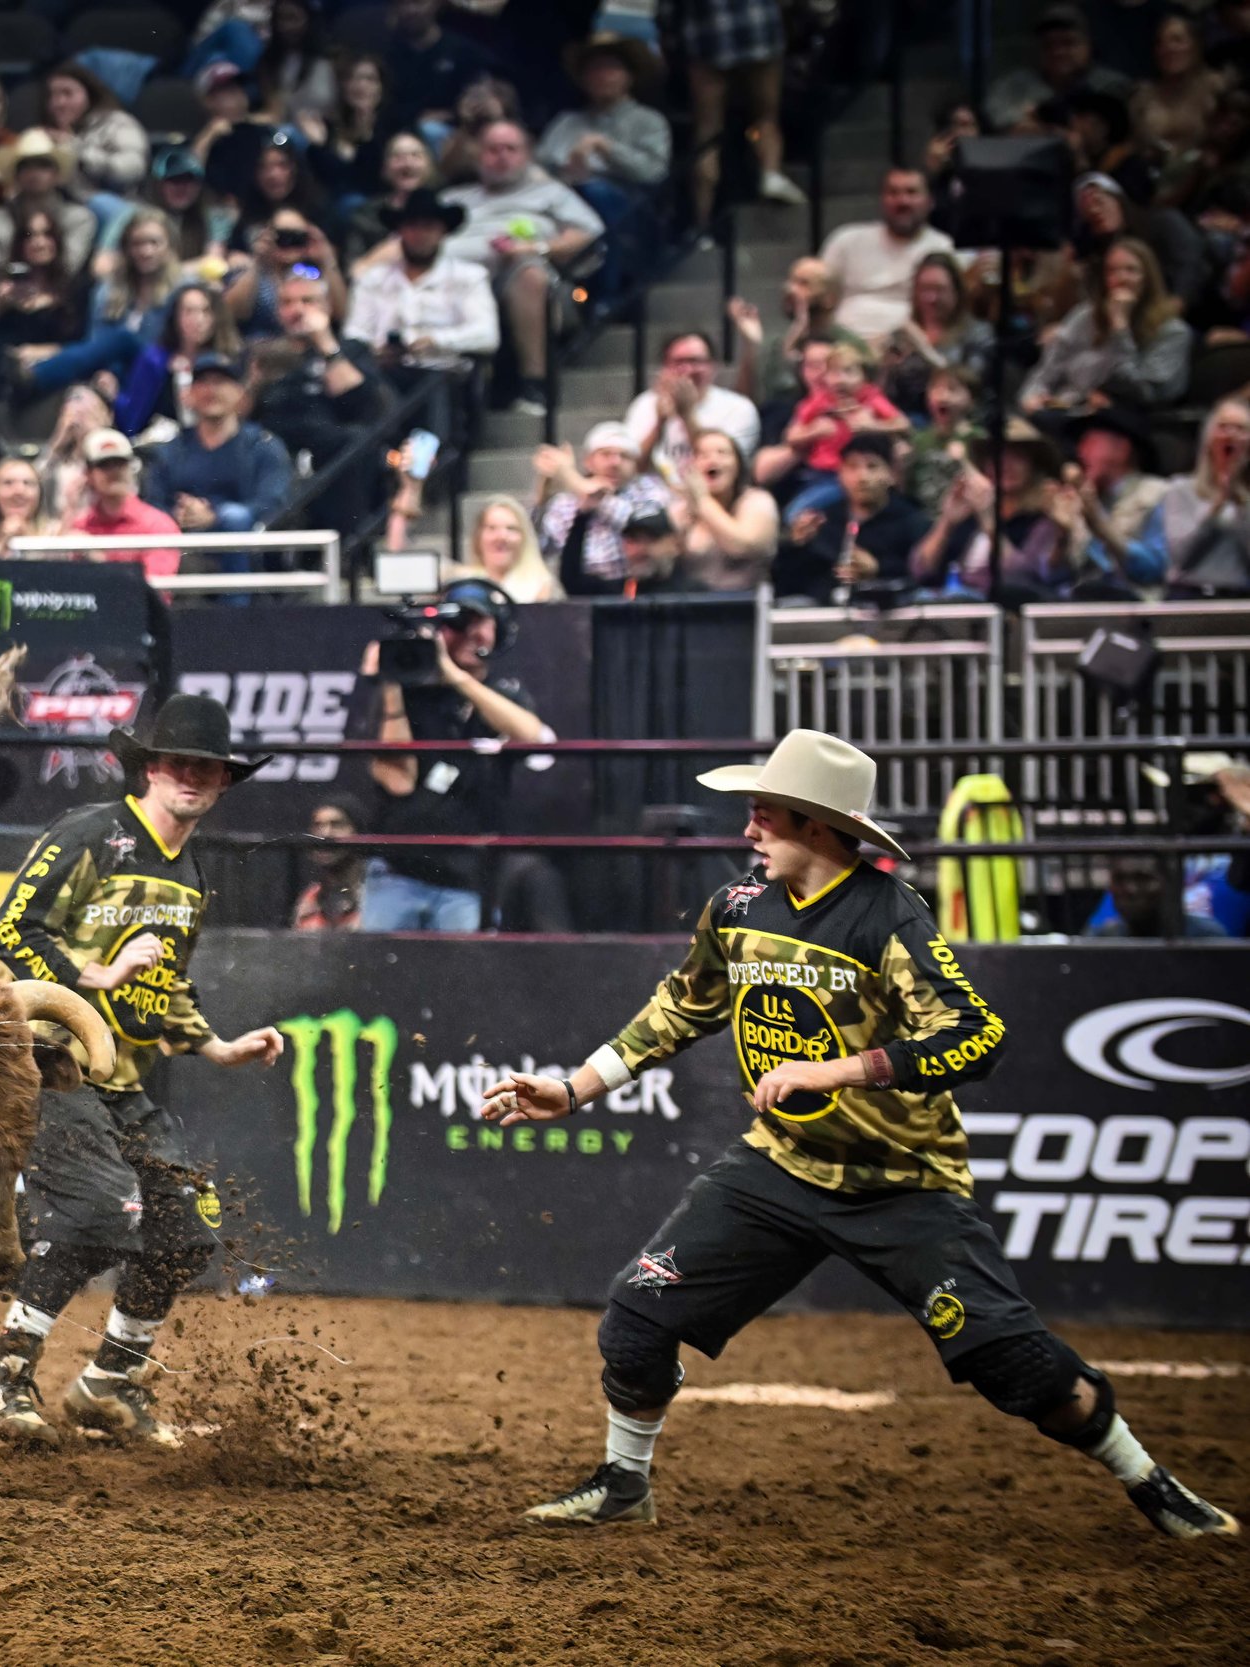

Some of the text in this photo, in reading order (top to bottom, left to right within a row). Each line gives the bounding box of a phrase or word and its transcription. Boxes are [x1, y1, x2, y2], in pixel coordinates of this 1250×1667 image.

[727, 960, 858, 994] OTECTED BY
[409, 1053, 682, 1121] MOER
[446, 1124, 634, 1154] ENERGY
[960, 1113, 1250, 1185] COOP
[993, 1193, 1250, 1264] TIRE
